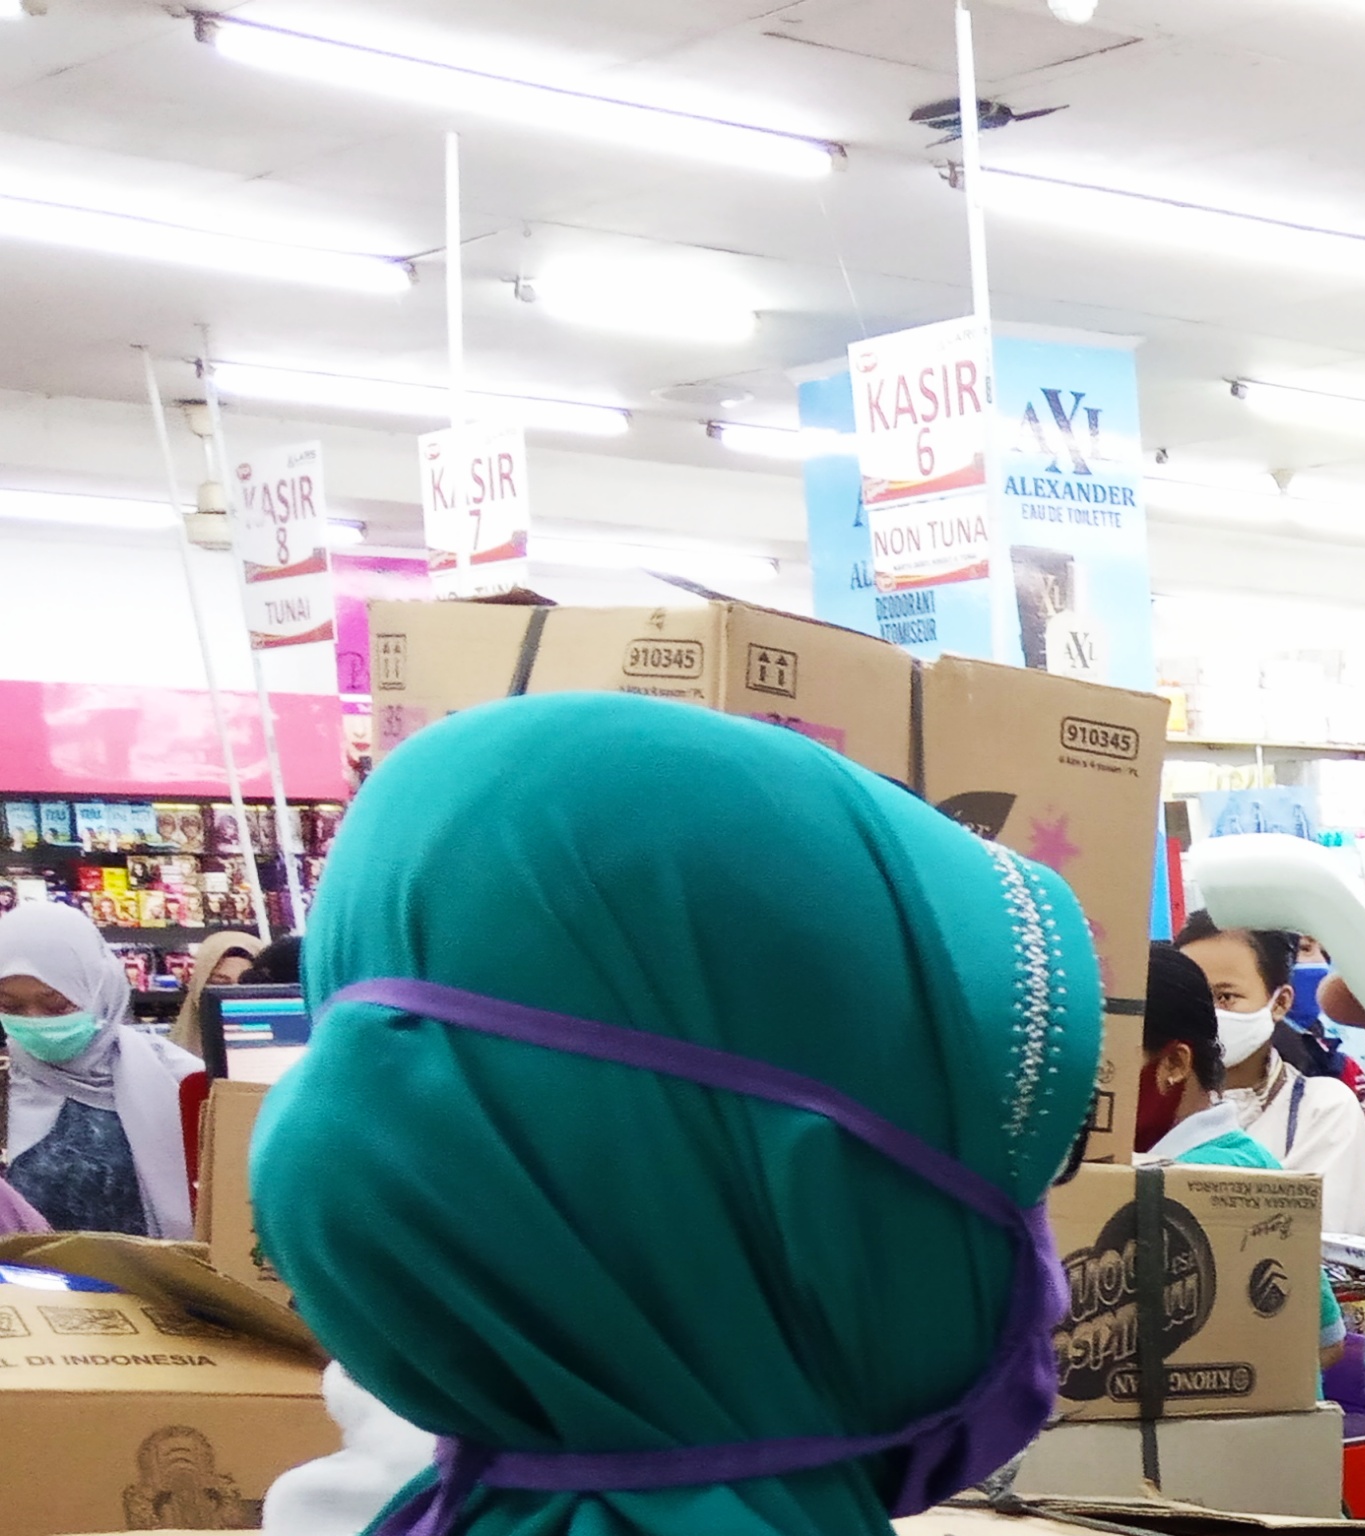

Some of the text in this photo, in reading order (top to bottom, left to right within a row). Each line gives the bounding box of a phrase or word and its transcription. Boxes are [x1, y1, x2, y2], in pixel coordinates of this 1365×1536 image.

[867, 359, 981, 433] KASIR
[916, 426, 935, 477] 6
[242, 474, 317, 528] KASIR
[1004, 475, 1137, 508] ALEXANDER
[468, 508, 482, 551] 7
[1021, 503, 1045, 520] EAU
[1048, 505, 1063, 523] DE
[276, 526, 290, 565] 8
[873, 514, 988, 557] NON TUNA
[264, 596, 311, 625] TUNAI
[1066, 723, 1132, 752] 910345
[25, 1354, 54, 1367] DI
[60, 1353, 218, 1368] INDONESIA
[1168, 1369, 1231, 1394] KHONG
